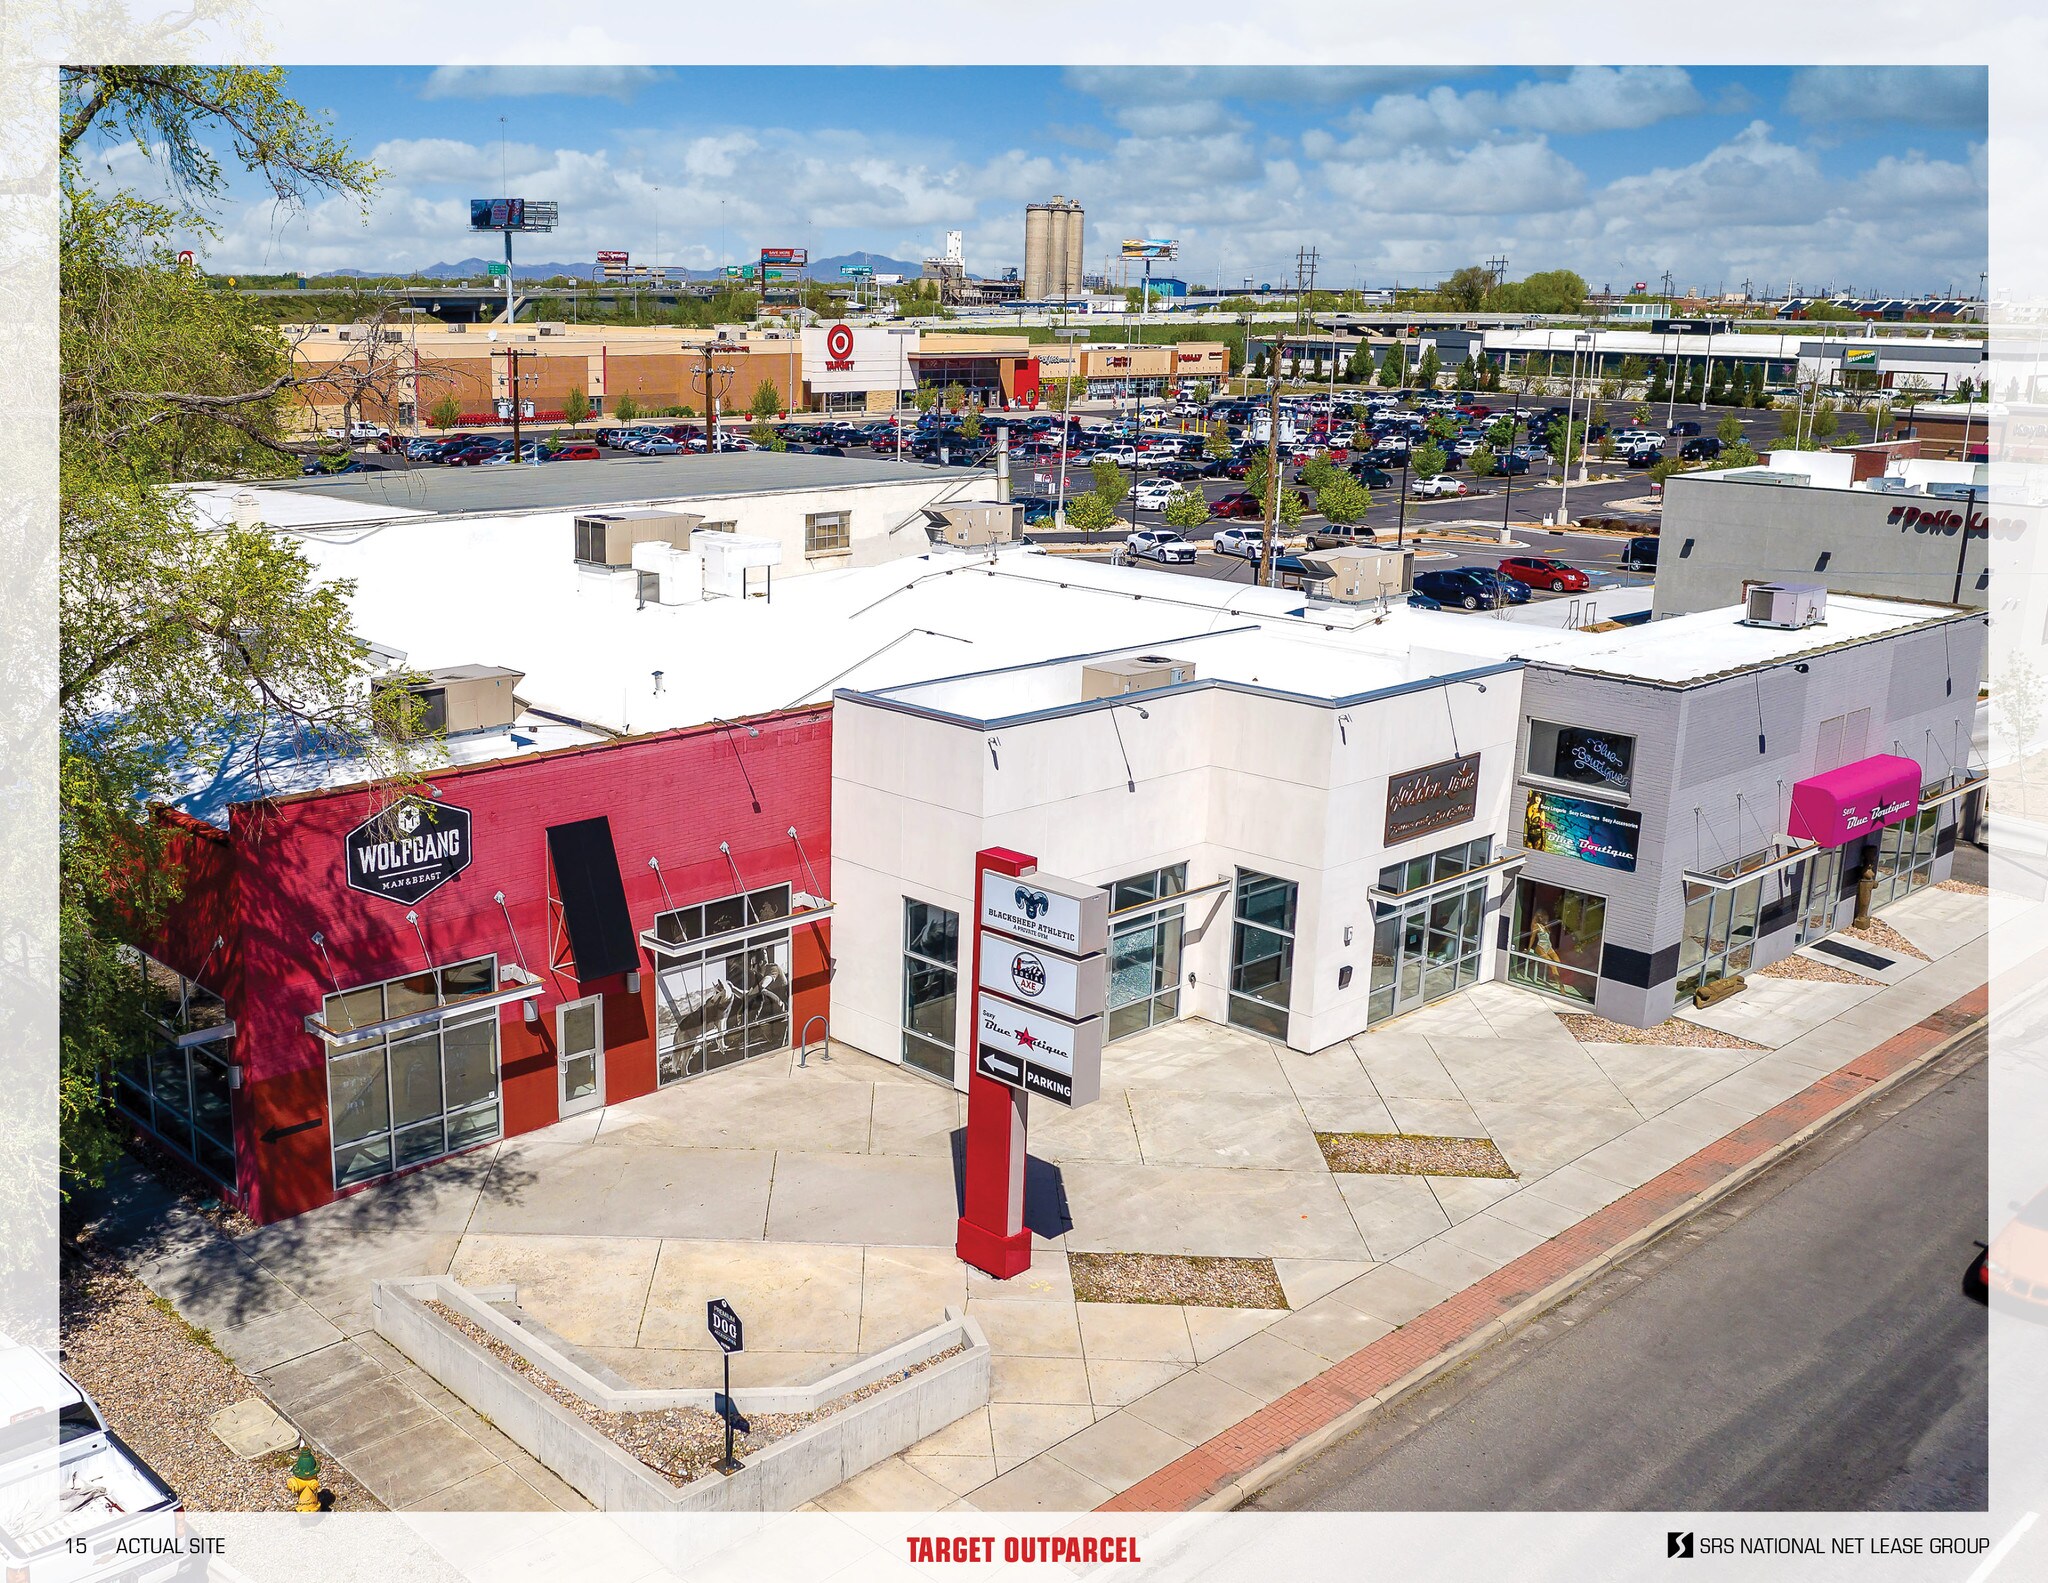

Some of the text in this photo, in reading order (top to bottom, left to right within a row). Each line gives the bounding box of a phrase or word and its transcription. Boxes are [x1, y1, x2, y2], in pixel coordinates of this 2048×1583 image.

[825, 360, 855, 372] TARGET
[1902, 506, 1964, 531] Pollo
[1571, 746, 1628, 785] Boutique
[1587, 738, 1623, 767] Blue
[1579, 812, 1600, 821] Costumes
[1602, 816, 1613, 824] Sexy
[1613, 819, 1639, 829] Accessories
[1842, 806, 1857, 817] Sexy
[1846, 800, 1911, 830] Blue Boutique
[357, 829, 460, 874] WOLFGANG
[1546, 831, 1574, 845] Blue
[1578, 838, 1635, 860] Boutique
[988, 908, 1075, 942] BLACKSHEEP ATHLETIC
[1017, 926, 1037, 937] PRIVATE
[1037, 932, 1049, 940] GYM
[1014, 969, 1044, 984] SOCIAL
[1020, 979, 1037, 991] AXE
[982, 1009, 996, 1020] Sexy
[984, 1018, 1069, 1058] Blue Boutique
[1027, 1071, 1071, 1097] PARKING
[713, 1313, 737, 1339] DOG
